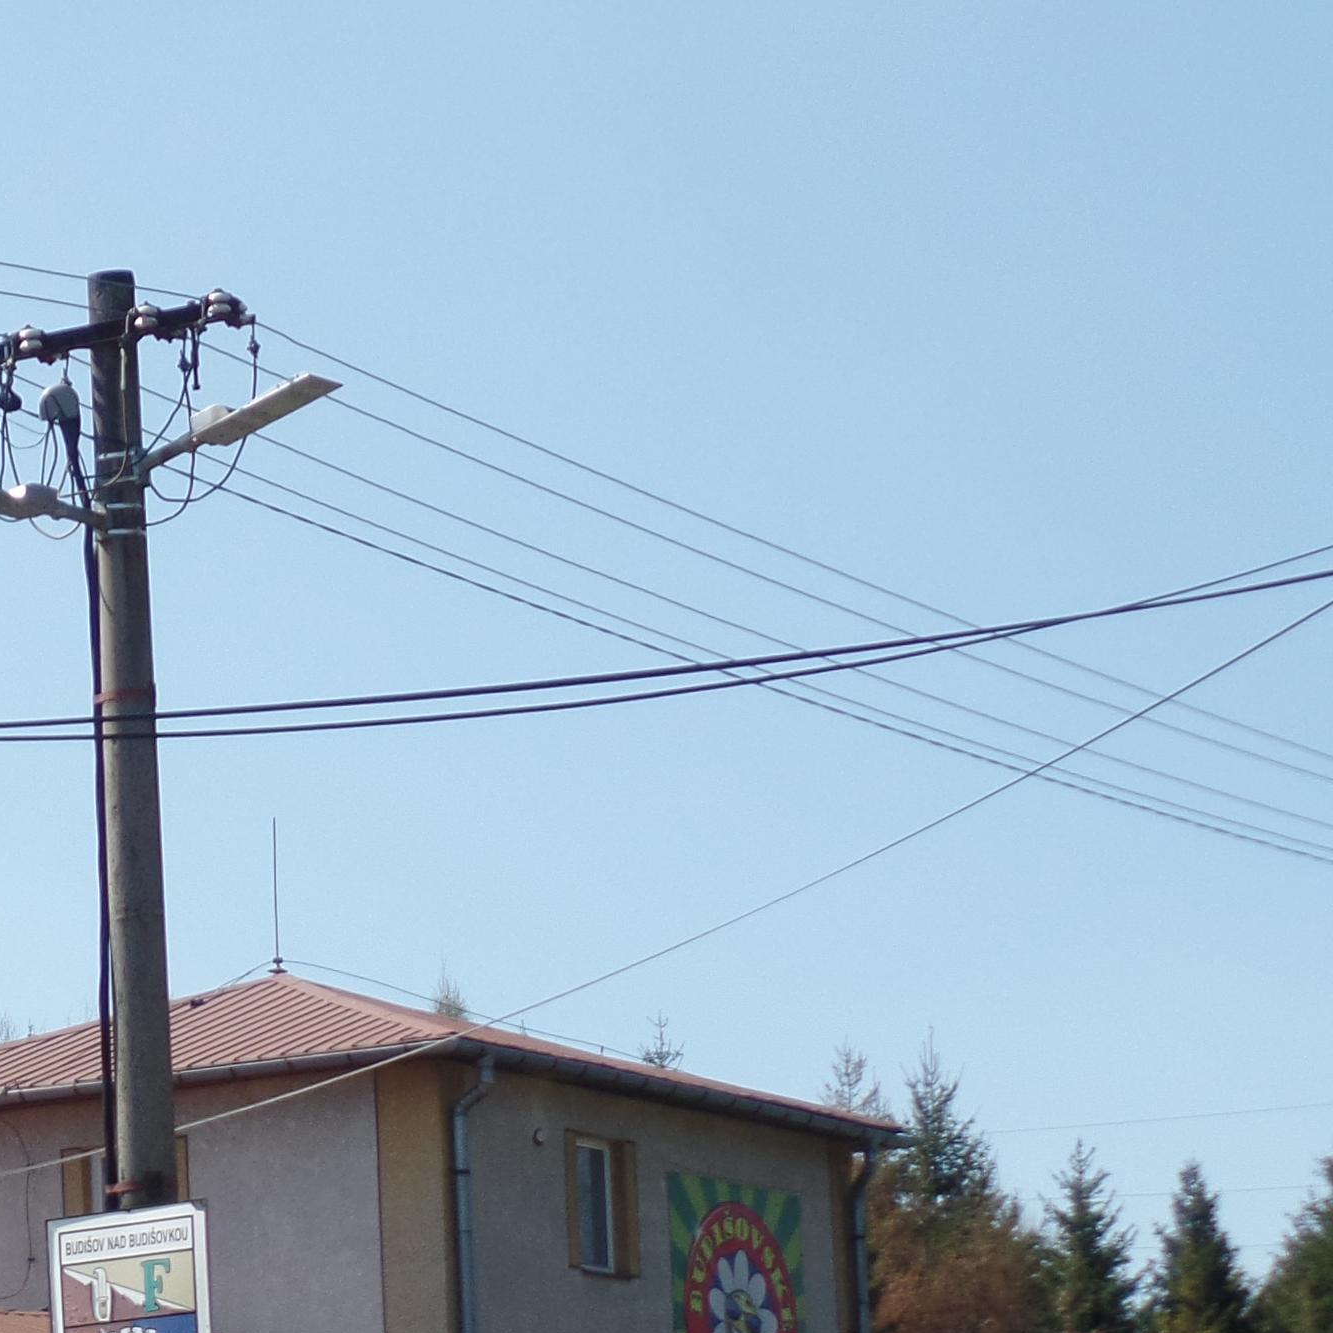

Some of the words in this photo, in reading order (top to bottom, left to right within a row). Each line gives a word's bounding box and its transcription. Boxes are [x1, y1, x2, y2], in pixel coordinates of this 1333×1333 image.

[65, 1236, 105, 1256] BUDIŠOV
[107, 1235, 127, 1250] NAD
[129, 1227, 189, 1247] BUDIŠOVKOU
[141, 1258, 171, 1312] F
